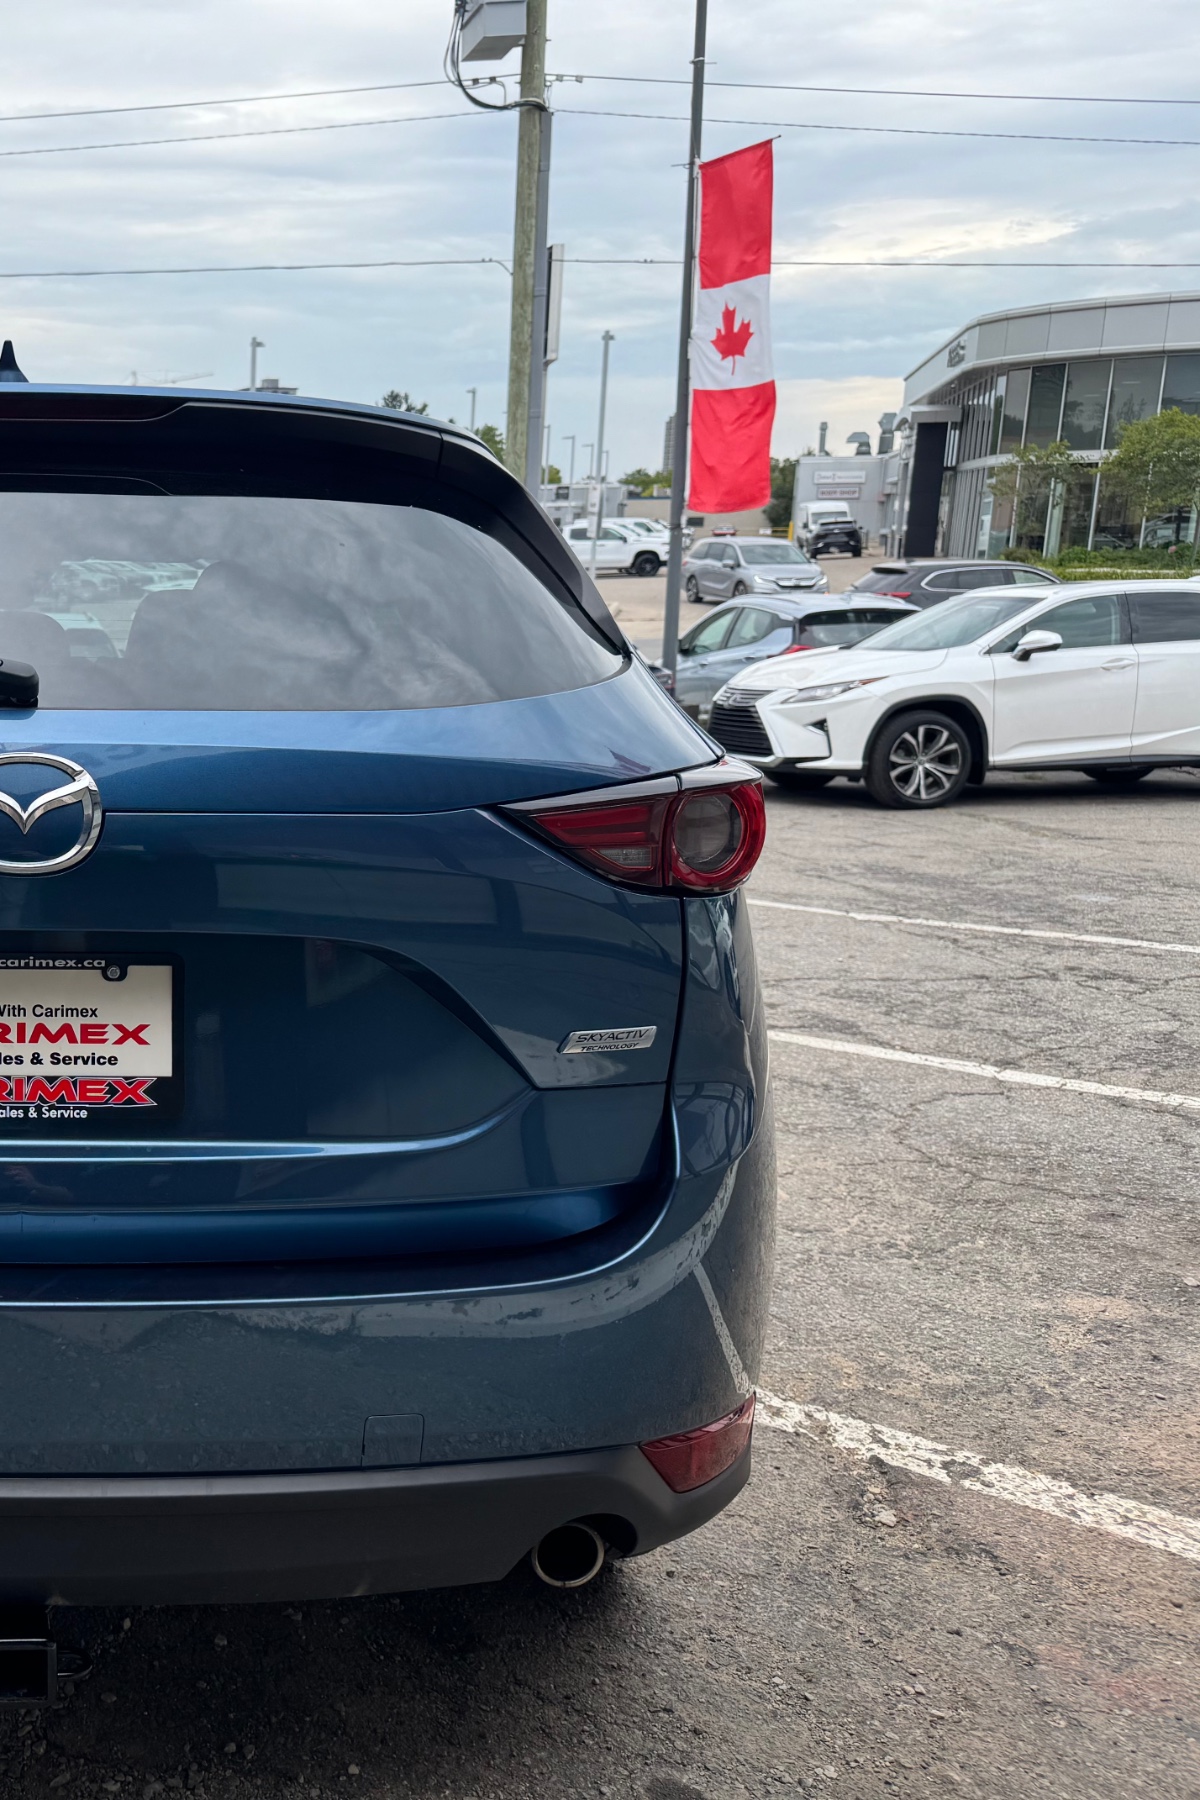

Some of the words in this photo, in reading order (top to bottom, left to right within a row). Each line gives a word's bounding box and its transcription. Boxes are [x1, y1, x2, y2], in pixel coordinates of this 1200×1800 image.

[31, 1004, 99, 1018] Carimex
[576, 1029, 648, 1042] SKYACTIV
[581, 1042, 639, 1051] TECHNOLOGY
[29, 1051, 45, 1066] &
[49, 1051, 119, 1067] Service
[28, 1106, 38, 1119] &
[41, 1106, 89, 1119] Service
